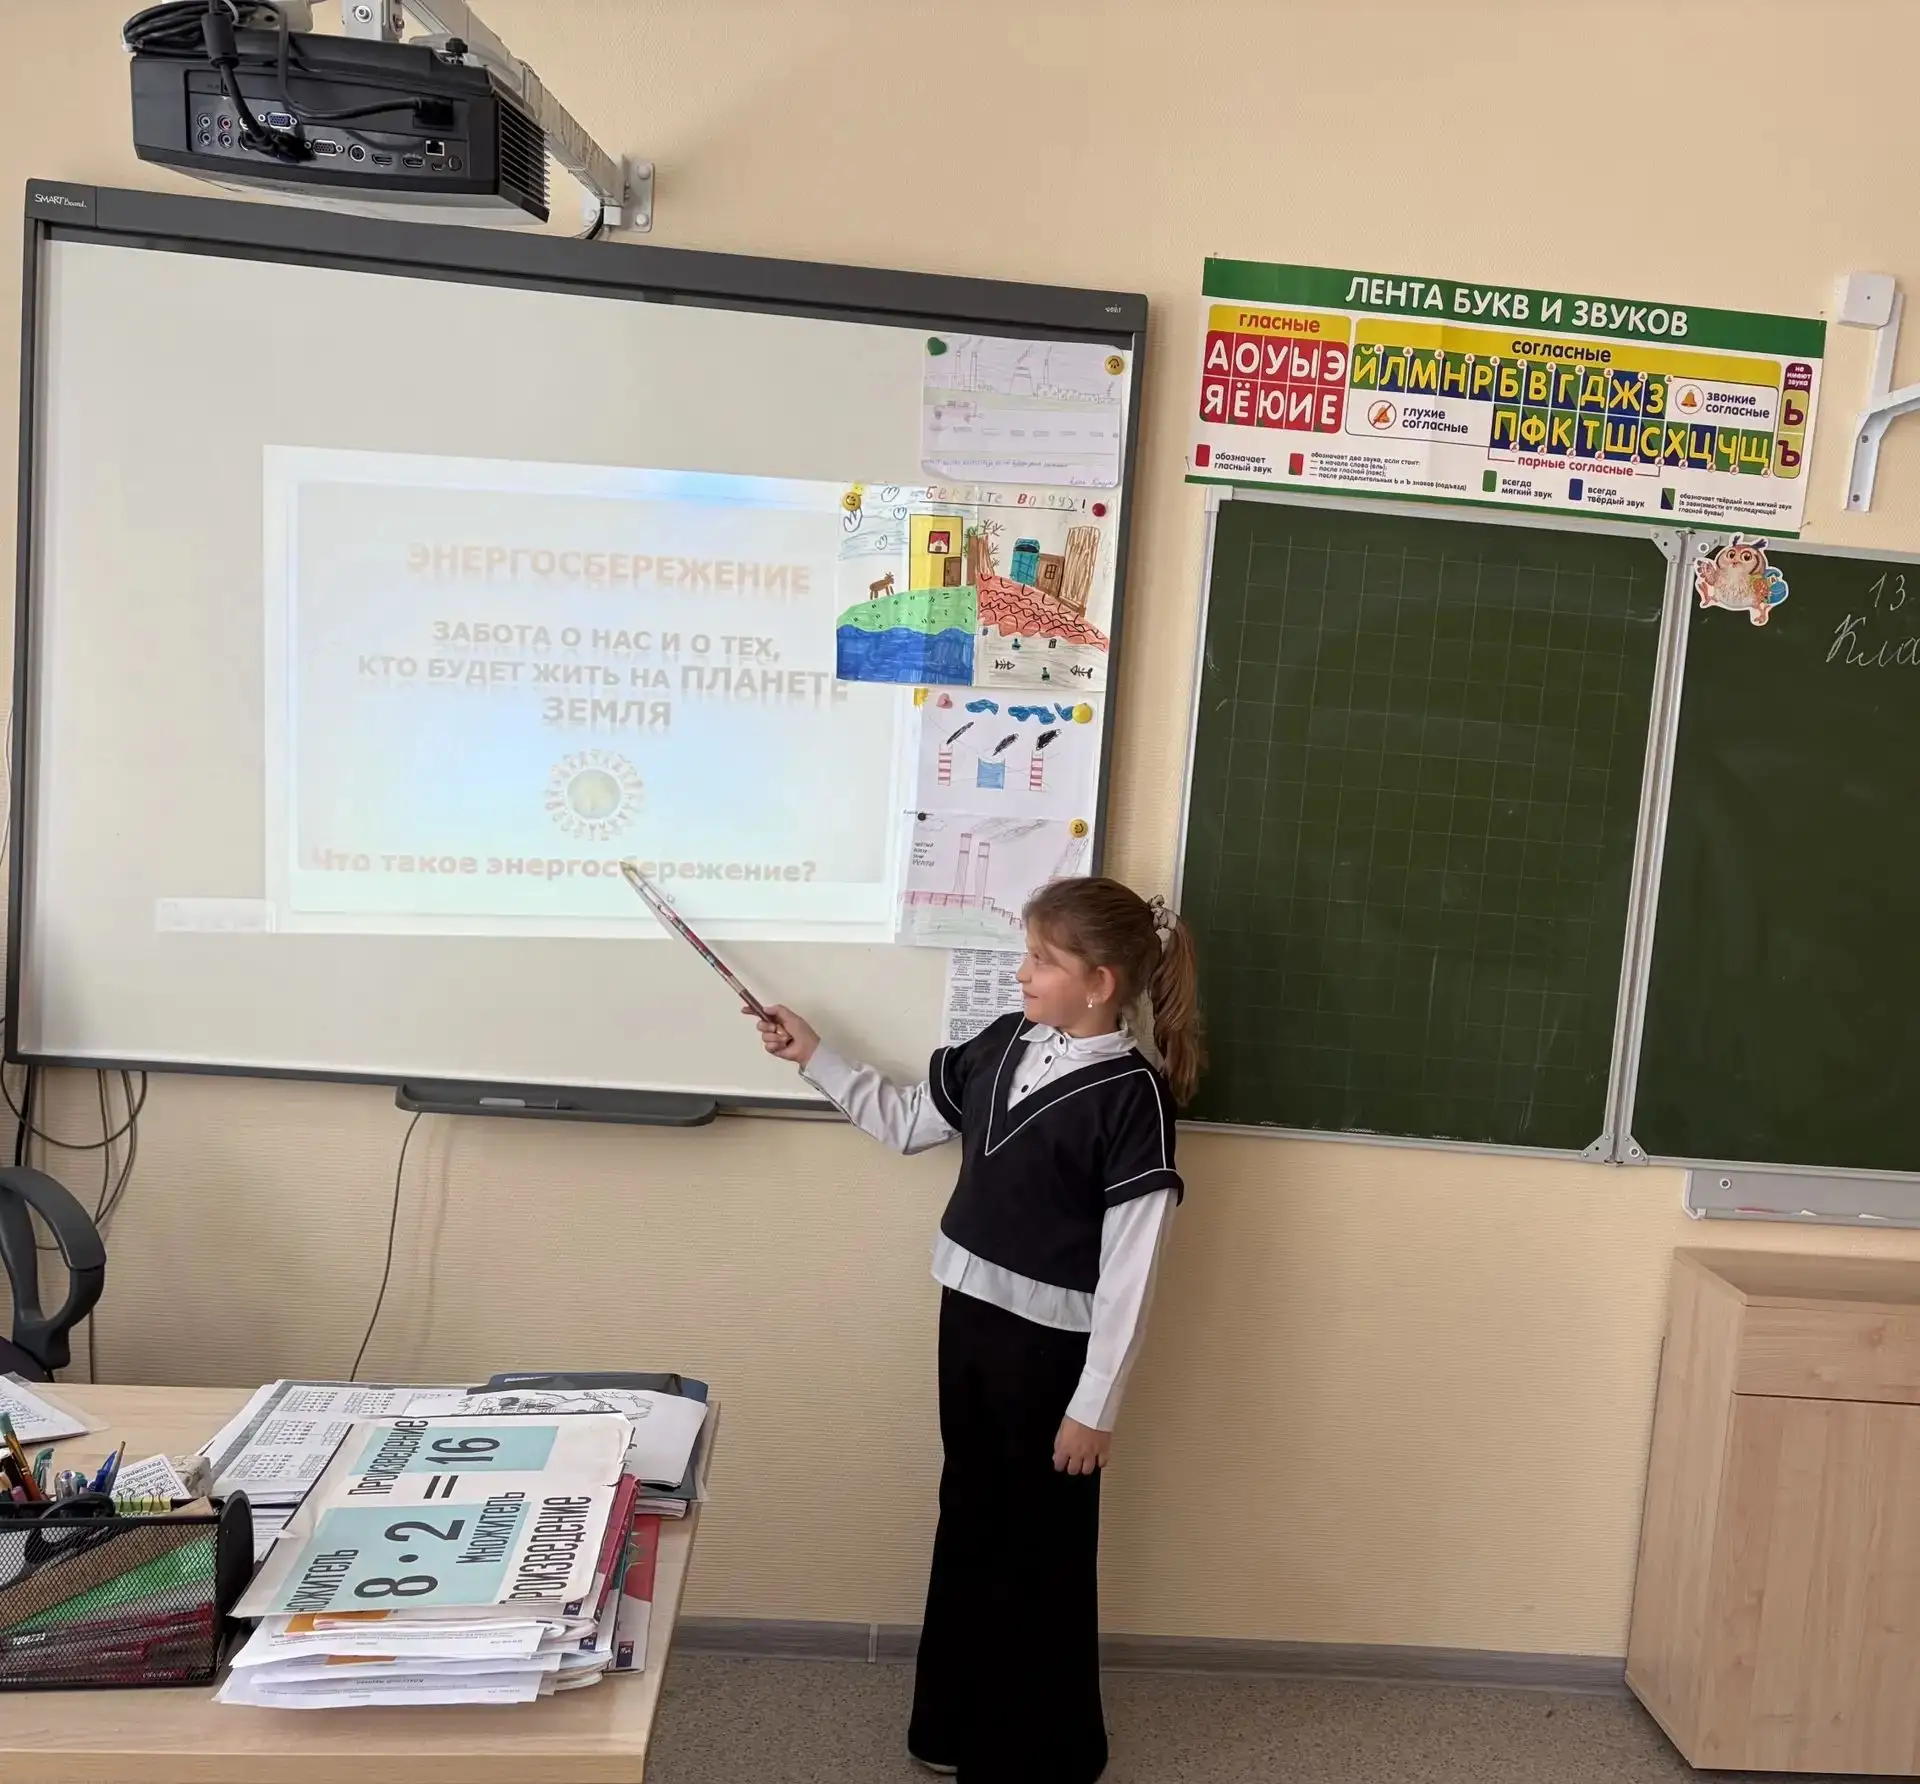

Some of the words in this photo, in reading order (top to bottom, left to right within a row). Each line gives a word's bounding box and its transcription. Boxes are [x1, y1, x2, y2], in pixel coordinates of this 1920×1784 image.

[35, 193, 64, 205] SMART
[1345, 276, 1444, 310] ЛЕНТА
[1453, 287, 1530, 320] БУКВ
[1540, 297, 1562, 324] И
[1571, 300, 1688, 337] ЗВУКОВ
[1239, 313, 1320, 333] гласные
[1511, 340, 1611, 362] согласные
[1787, 379, 1809, 387] звука
[1707, 392, 1756, 405] звонкие
[1403, 408, 1446, 420] глухие
[1706, 404, 1770, 418] согласные
[1402, 419, 1469, 434] согласные
[1215, 452, 1266, 463] обозначает
[1311, 452, 1347, 460] обозначает
[1214, 462, 1250, 471] гласный
[1253, 466, 1272, 475] звук
[1518, 456, 1565, 470] парные
[1569, 461, 1634, 476] согласные
[1502, 478, 1532, 488] всегда
[1501, 487, 1532, 496] мягкий
[1533, 490, 1552, 499] звук
[1587, 487, 1616, 497] всегда
[1626, 499, 1645, 508] звук
[405, 541, 811, 593] ЭНЕРГОСБЕРЕЖЕНИЕ
[432, 620, 551, 646] ЗАБОТА
[560, 627, 582, 647] О
[591, 629, 652, 651] НАС
[661, 632, 681, 652] И
[691, 633, 711, 655] О
[720, 635, 780, 662] ТЕХ,
[358, 655, 418, 678] КТО
[427, 658, 525, 685] БУДЕТ
[531, 662, 621, 687] ЖИТЬ
[630, 667, 670, 689] НА
[681, 665, 848, 700] ПЛАНЕТЕ
[542, 696, 671, 726] ЗЕМЛЯ
[311, 847, 371, 872] Что
[380, 854, 478, 875] такое
[486, 855, 817, 882] энергосережение?
[425, 1437, 500, 1465] 16
[384, 1519, 465, 1542] 2
[354, 1575, 438, 1598] 8
